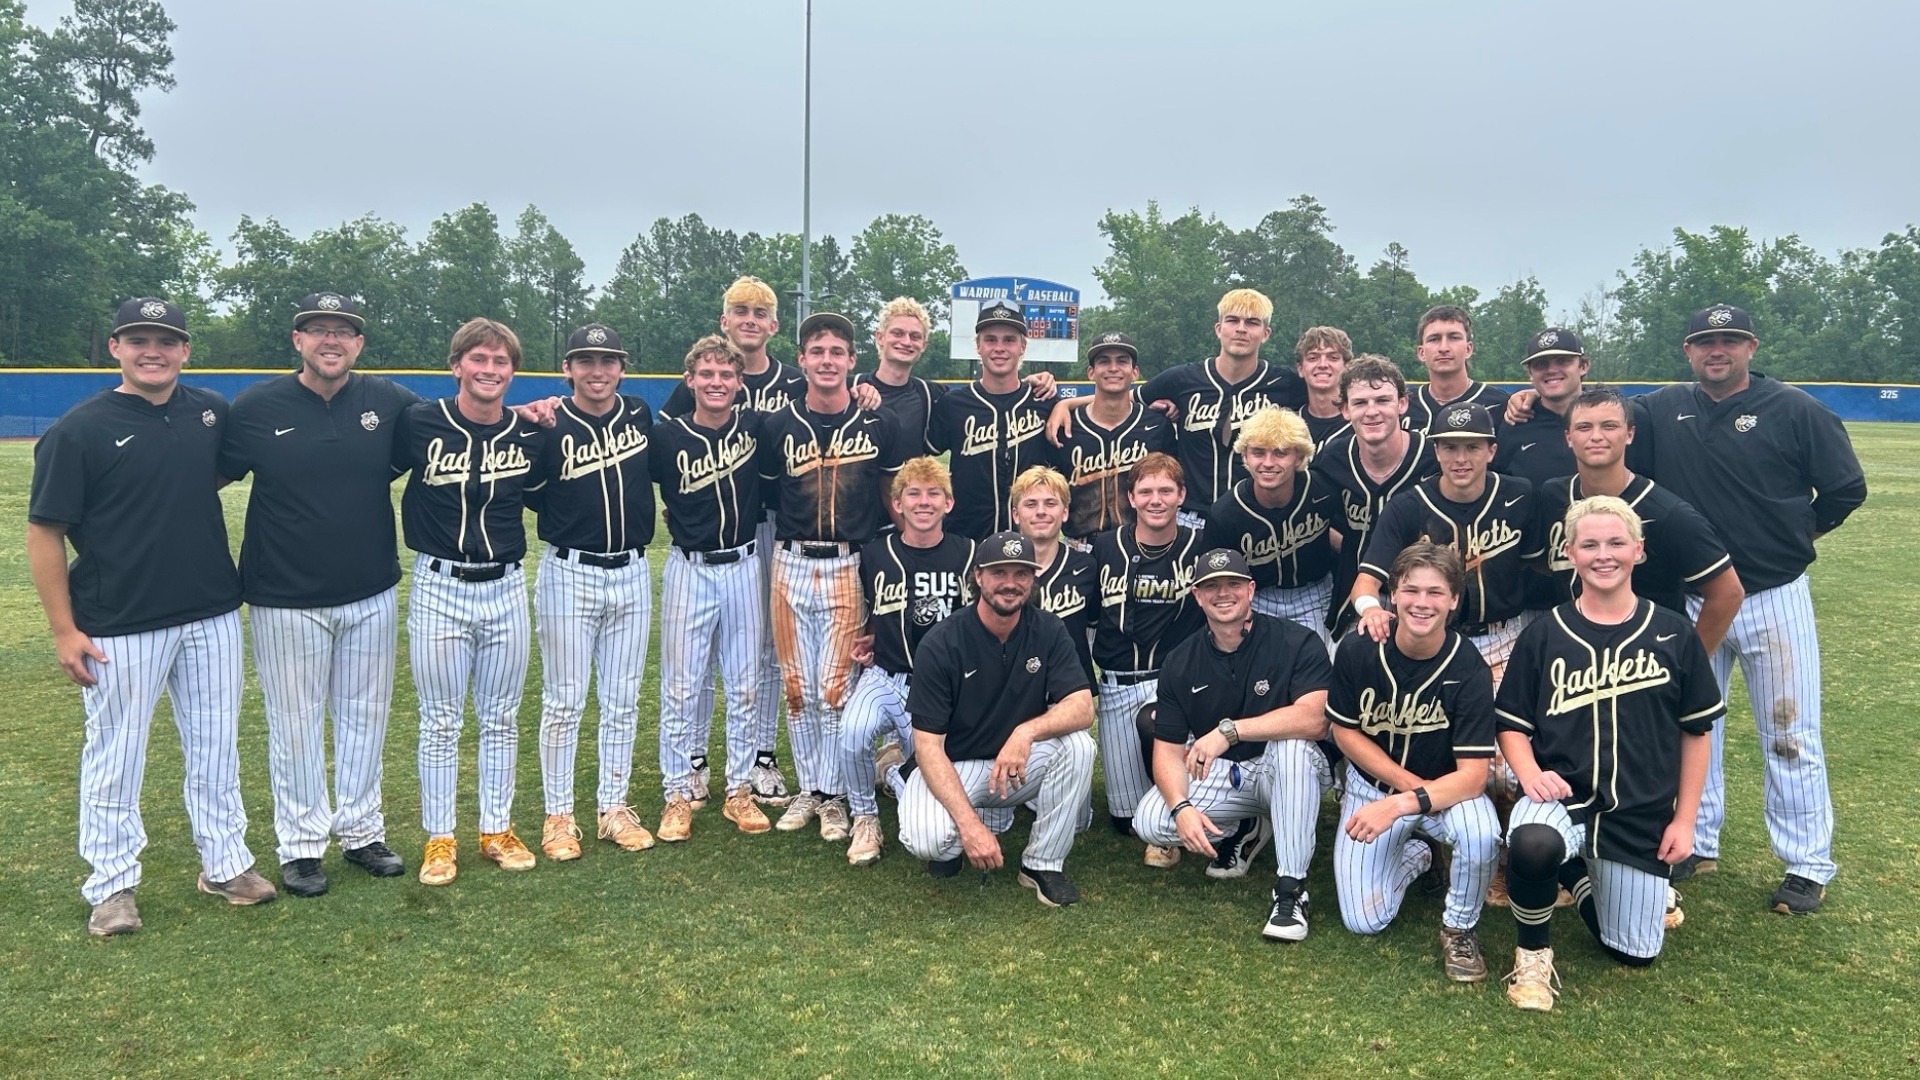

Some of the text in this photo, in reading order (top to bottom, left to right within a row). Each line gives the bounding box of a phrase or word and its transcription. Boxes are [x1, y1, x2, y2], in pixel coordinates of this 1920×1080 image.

[959, 286, 1008, 299] WARRIOR
[1028, 290, 1074, 302] BASEBALL
[731, 388, 790, 413] ackets
[1060, 387, 1077, 398] 350
[1880, 389, 1899, 399] 375
[560, 423, 648, 481] Jackets
[784, 428, 879, 477] Jackets
[960, 408, 1046, 456] Jackets
[676, 431, 757, 495] Jackets
[1241, 513, 1330, 567] Jackets
[1040, 583, 1086, 619] kets
[1546, 647, 1671, 716] Jackets
[1359, 687, 1450, 736] Jackes
